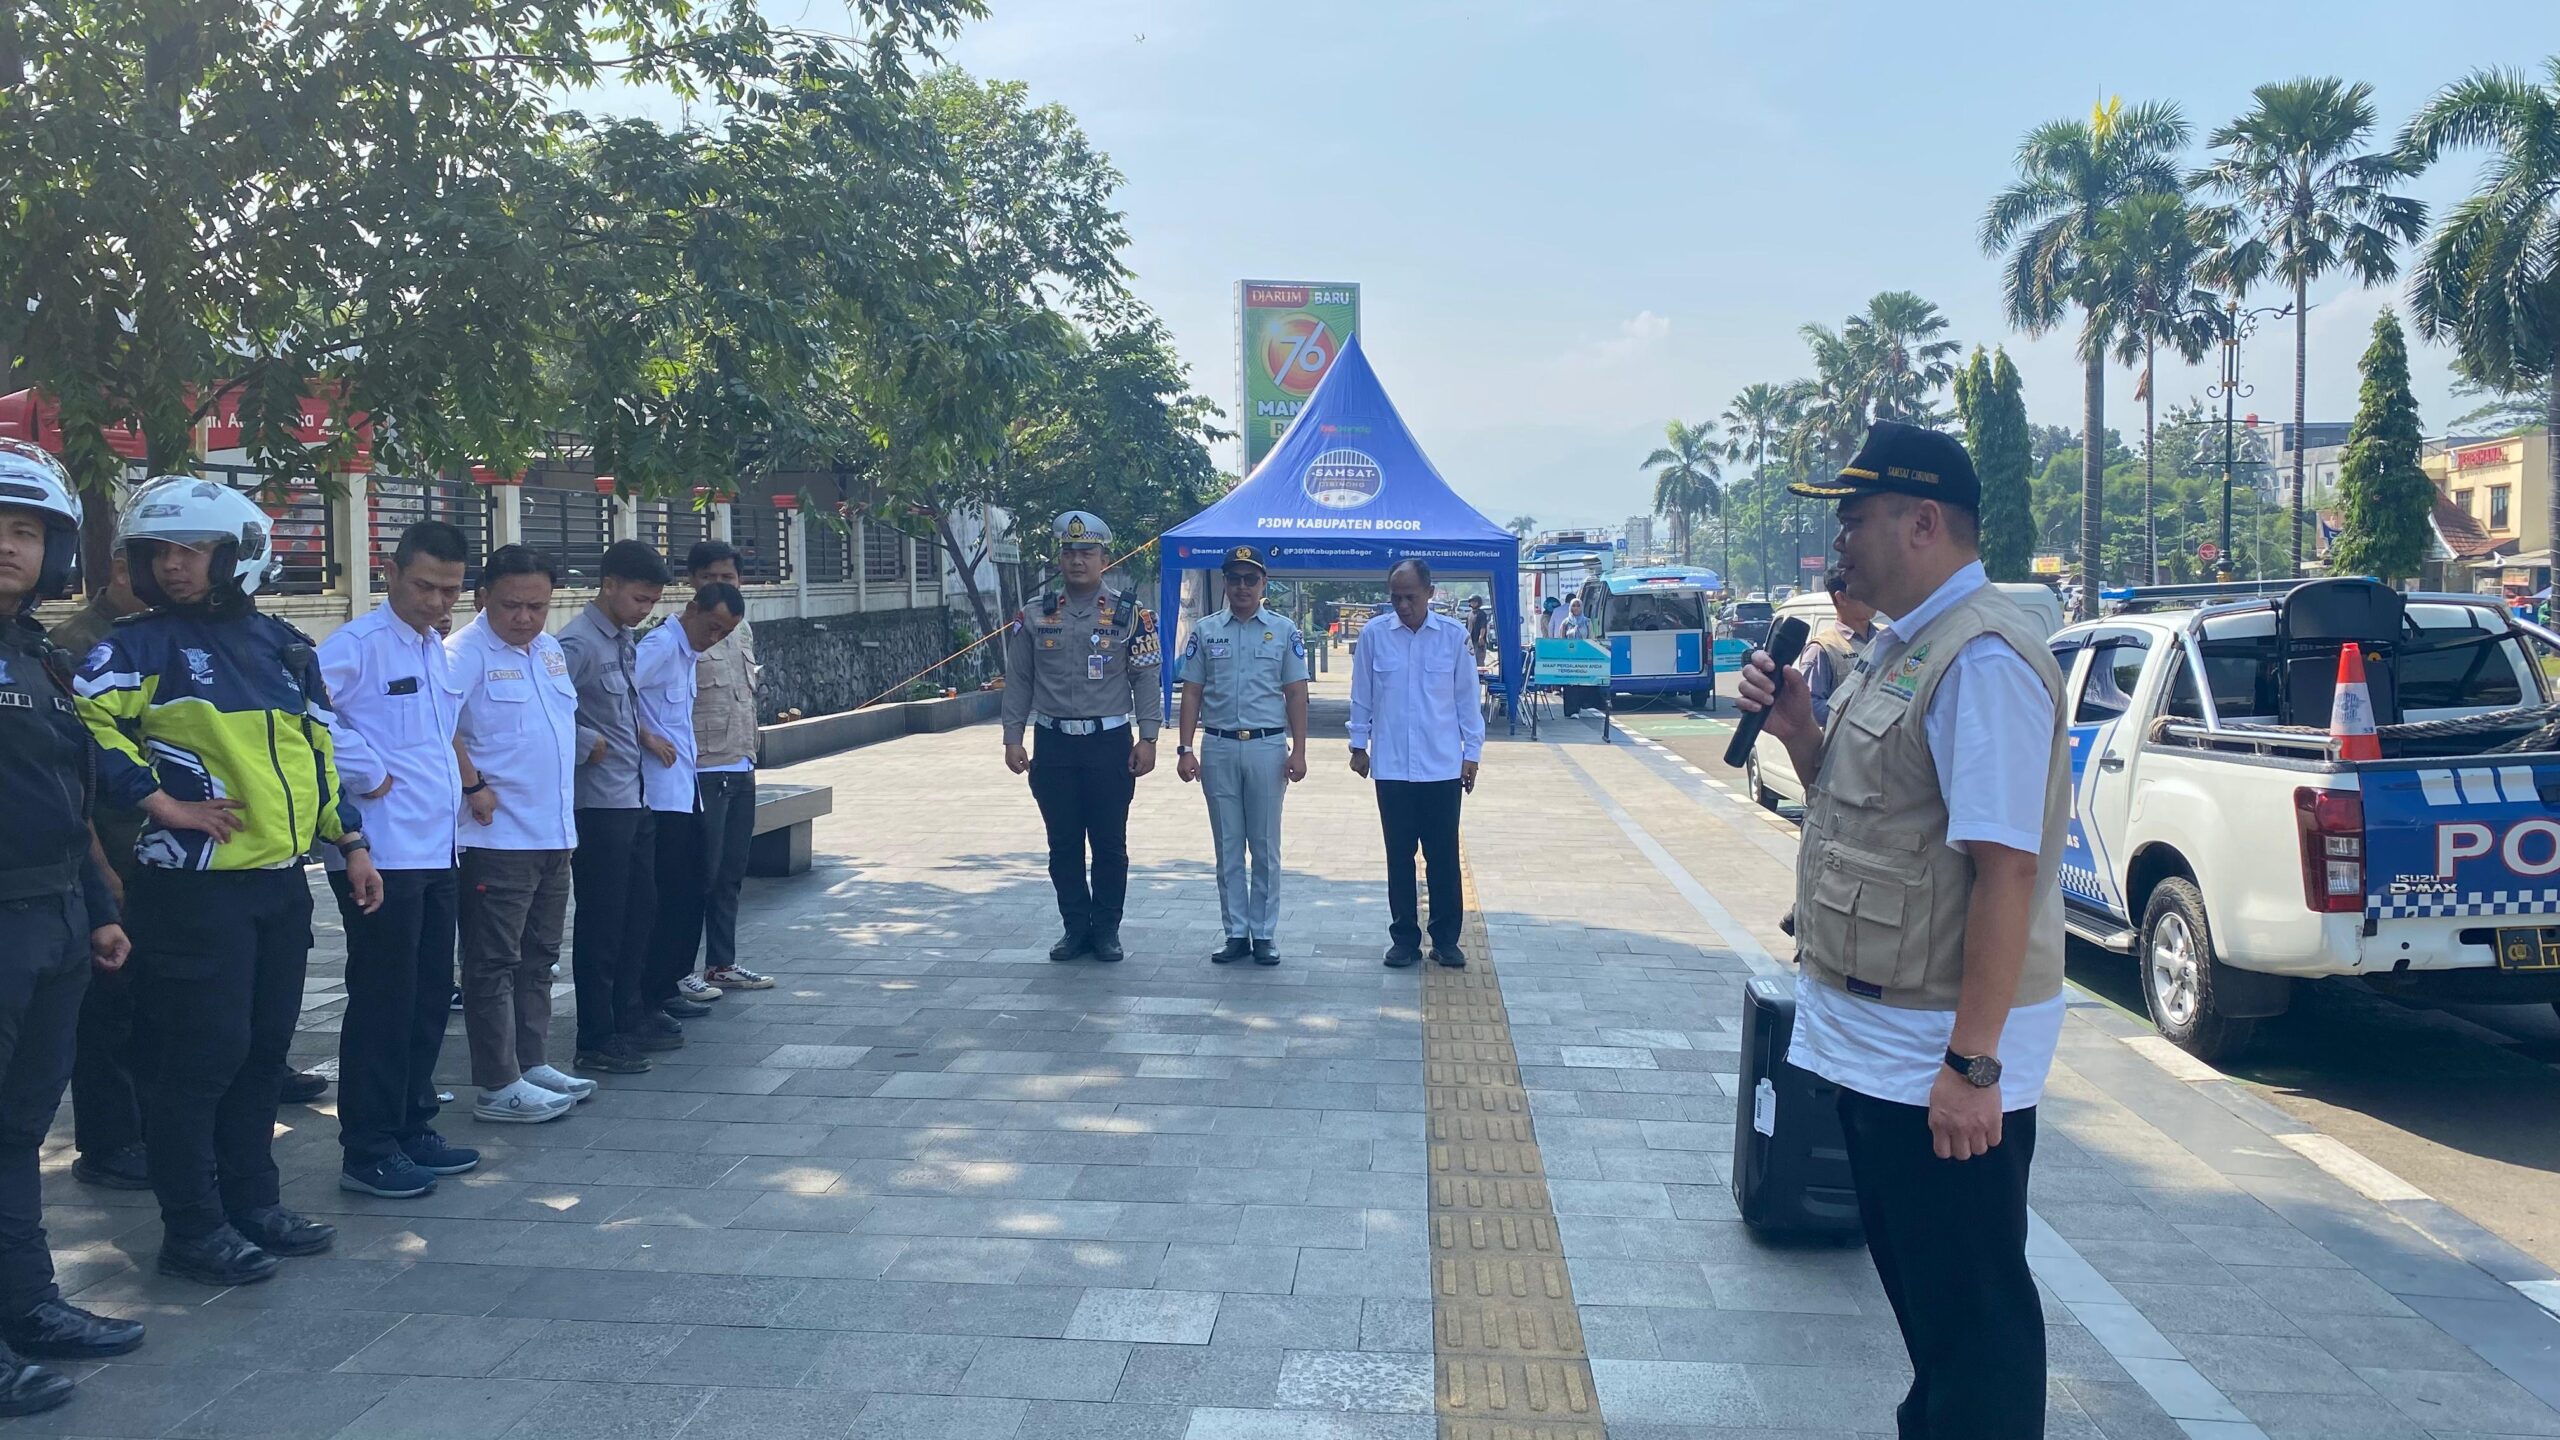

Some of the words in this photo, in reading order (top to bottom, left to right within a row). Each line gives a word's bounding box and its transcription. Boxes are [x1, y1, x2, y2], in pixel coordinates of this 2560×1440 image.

[1252, 289, 1302, 303] DJARUM
[1315, 291, 1350, 305] BARU
[1273, 320, 1326, 386] 76
[1315, 468, 1372, 478] SAMSAT
[1257, 518, 1293, 528] P3DW
[1296, 518, 1372, 529] KABUPATEN
[1375, 520, 1421, 531] BOGOR
[1093, 628, 1119, 637] POLRI
[2396, 874, 2440, 883] ISUZU
